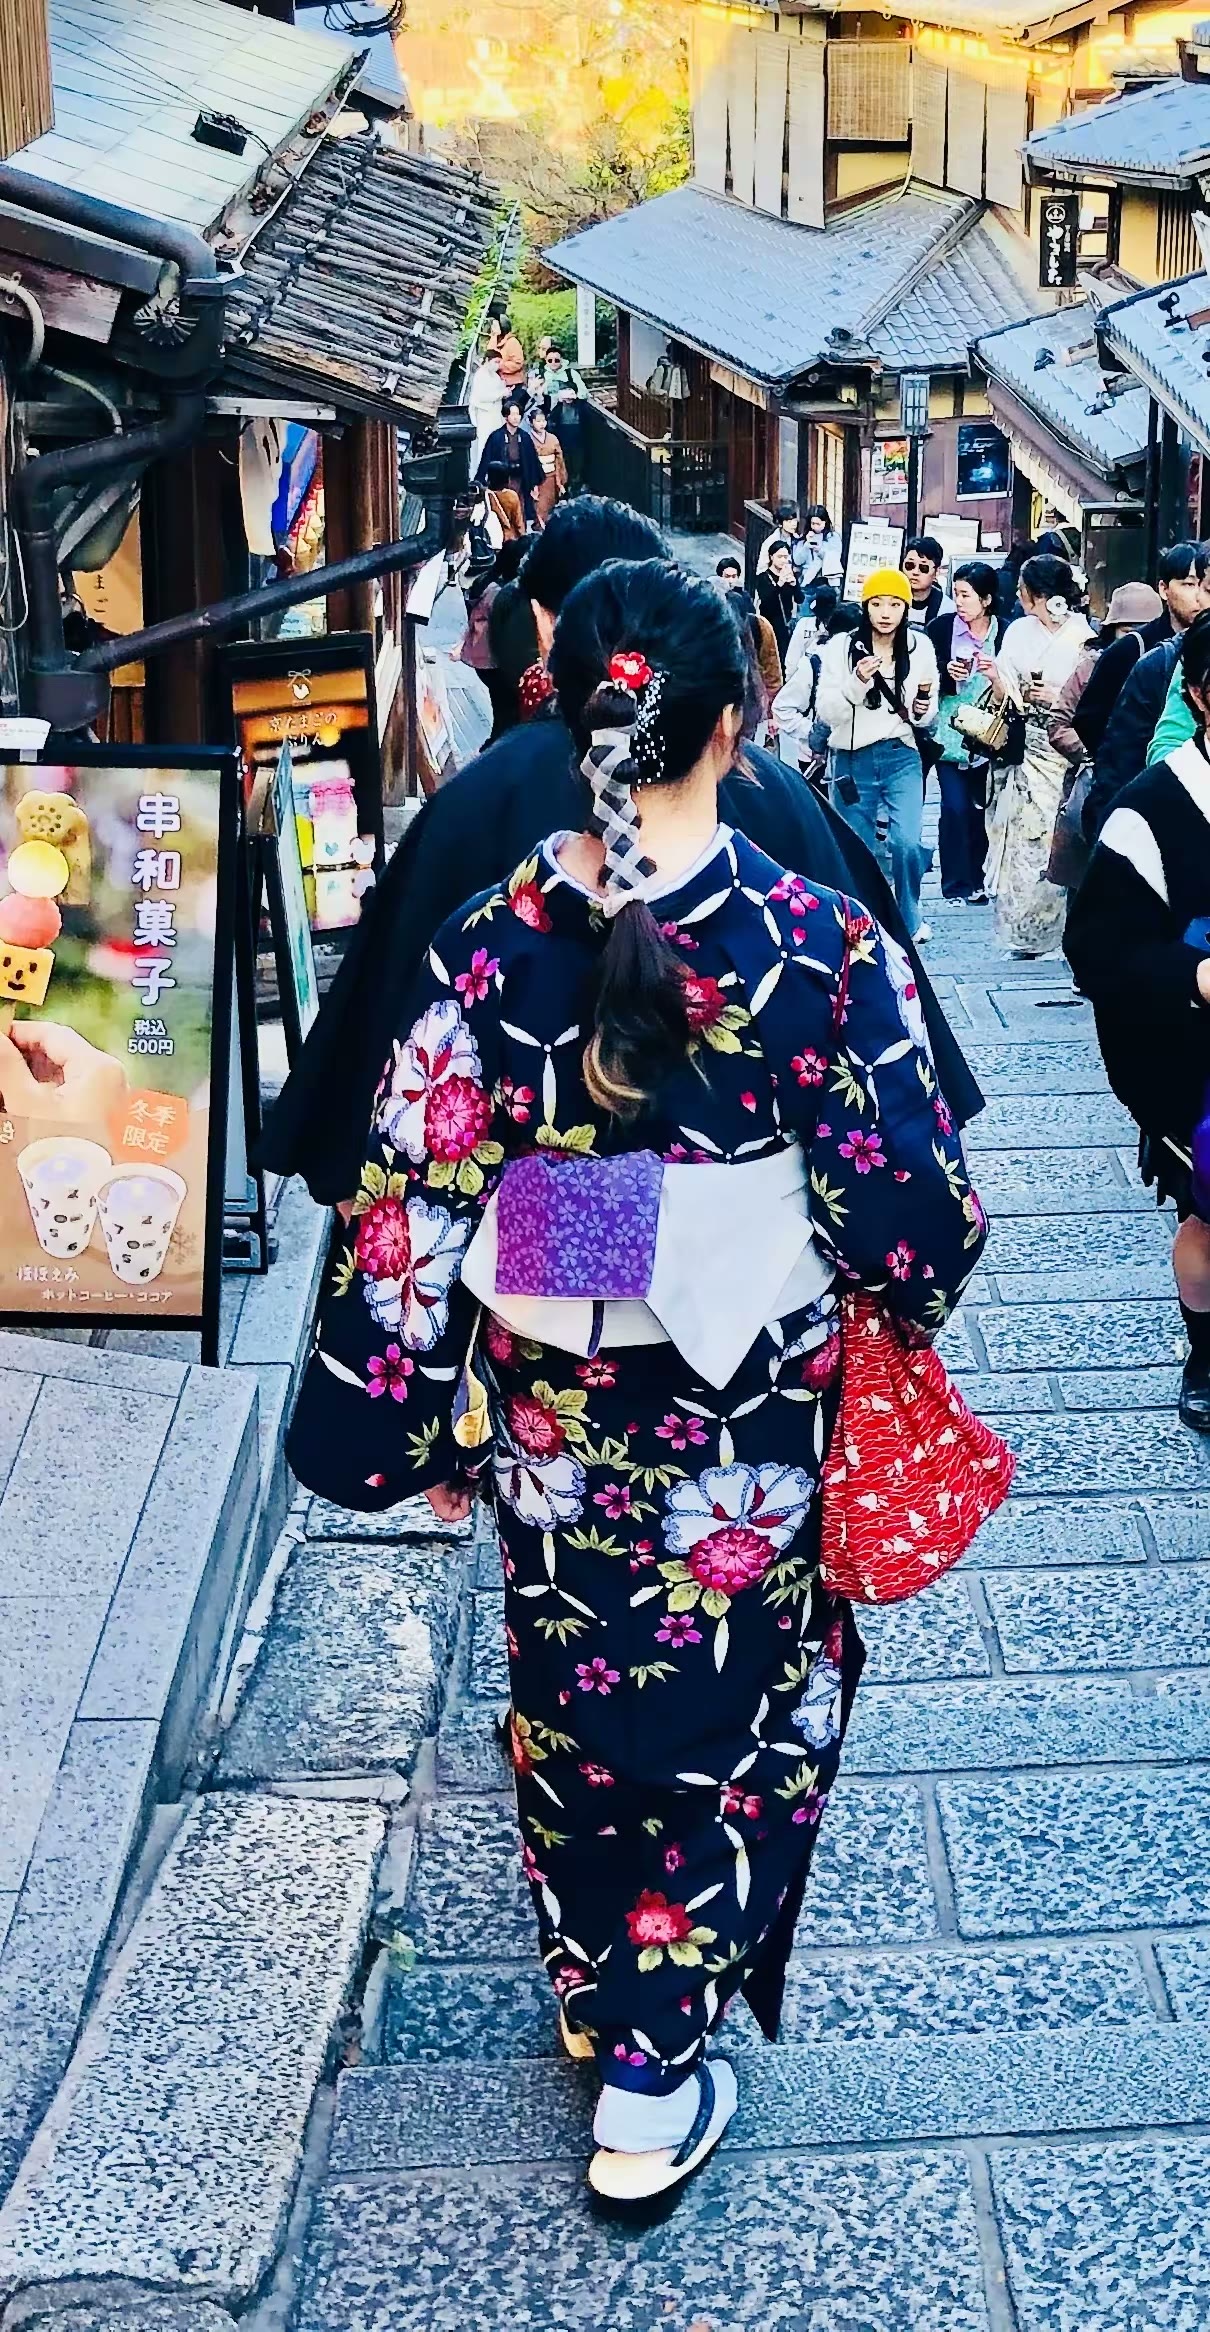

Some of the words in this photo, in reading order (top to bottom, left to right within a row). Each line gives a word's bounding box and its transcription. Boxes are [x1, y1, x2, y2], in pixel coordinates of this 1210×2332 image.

[131, 792, 182, 1006] 串和菓子
[133, 1019, 167, 1037] 税込
[127, 1038, 175, 1056] 500円
[128, 1099, 177, 1128] 冬季
[122, 1125, 170, 1155] 限定
[17, 1264, 80, 1283] ほほえみ
[41, 1287, 174, 1304] ホットコーヒー・ココア
